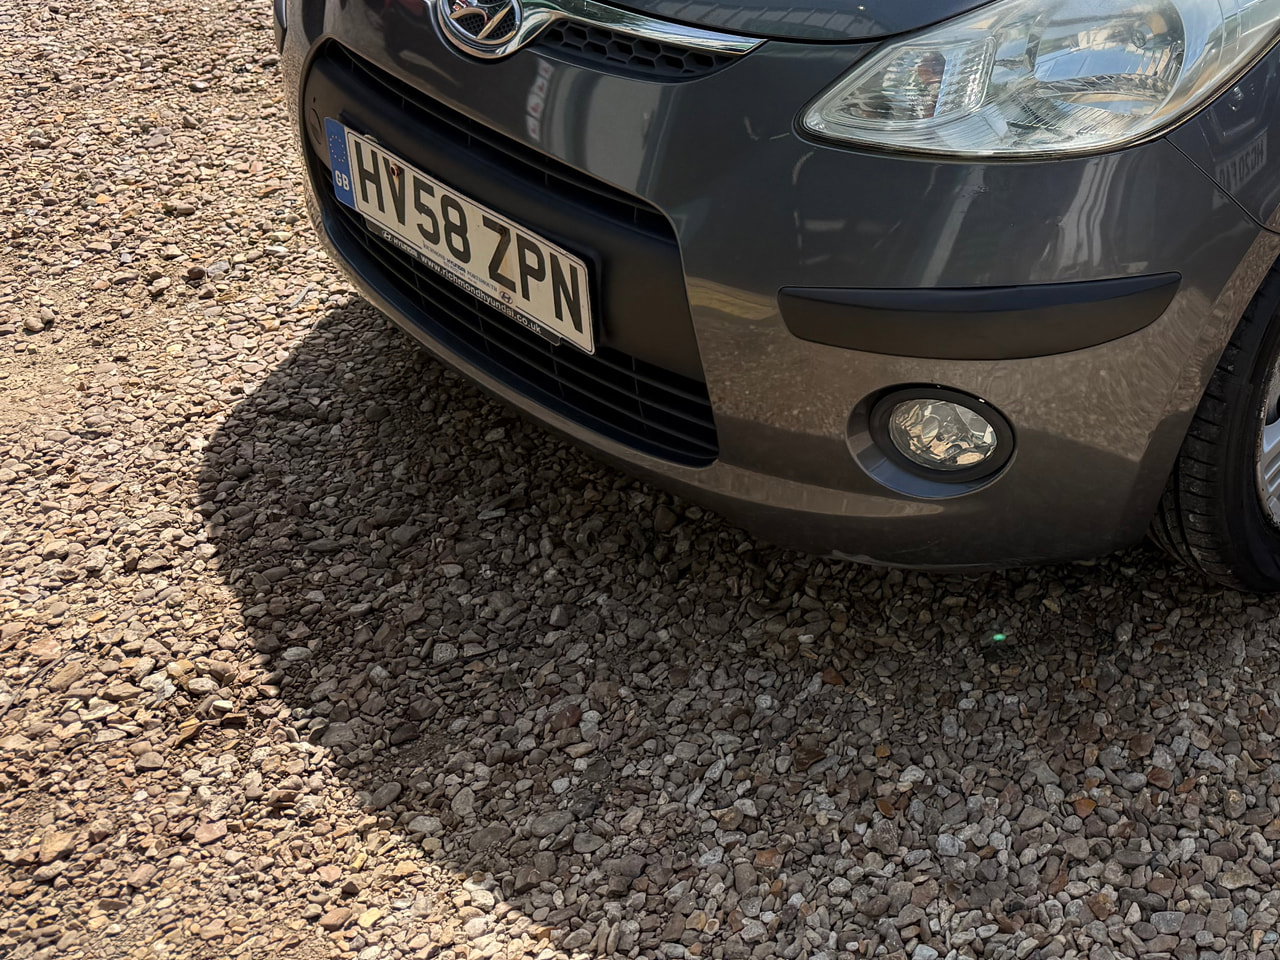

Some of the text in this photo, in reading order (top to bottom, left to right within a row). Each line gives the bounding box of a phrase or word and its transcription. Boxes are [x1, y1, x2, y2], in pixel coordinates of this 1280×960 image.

[334, 170, 350, 191] GB
[354, 140, 584, 335] HV58 ZPN
[420, 254, 542, 334] www.richmondhyundai.co.uk
